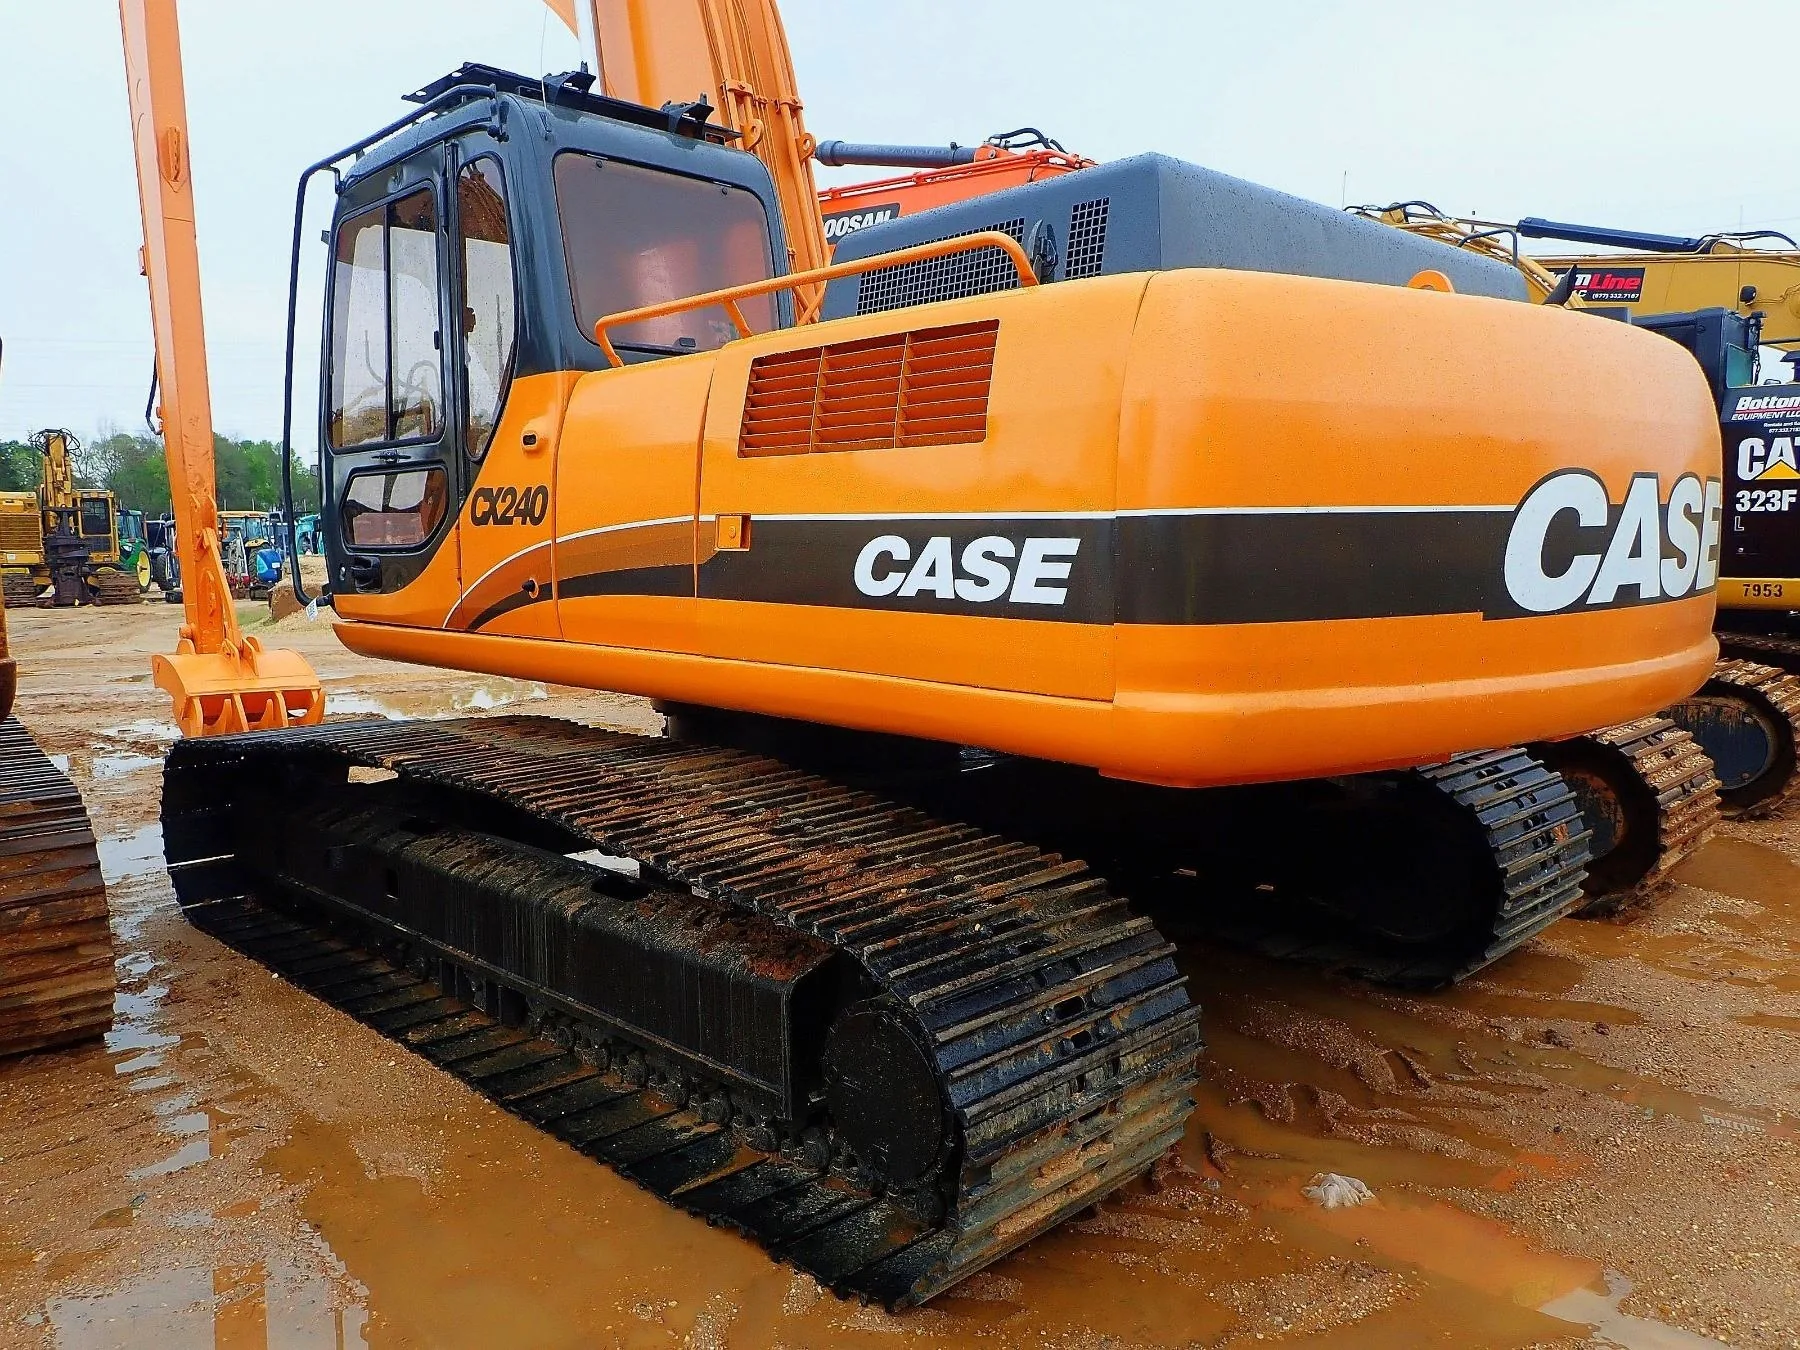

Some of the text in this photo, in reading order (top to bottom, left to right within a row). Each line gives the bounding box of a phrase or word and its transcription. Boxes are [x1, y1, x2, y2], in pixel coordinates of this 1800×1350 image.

[824, 209, 892, 238] OOSAN
[1731, 411, 1786, 421] EQUIPMENT
[471, 485, 549, 526] CX240
[1735, 489, 1798, 512] 323F
[1504, 473, 1722, 612] CASE
[854, 535, 1081, 605] CASE
[1743, 584, 1783, 597] 7953
